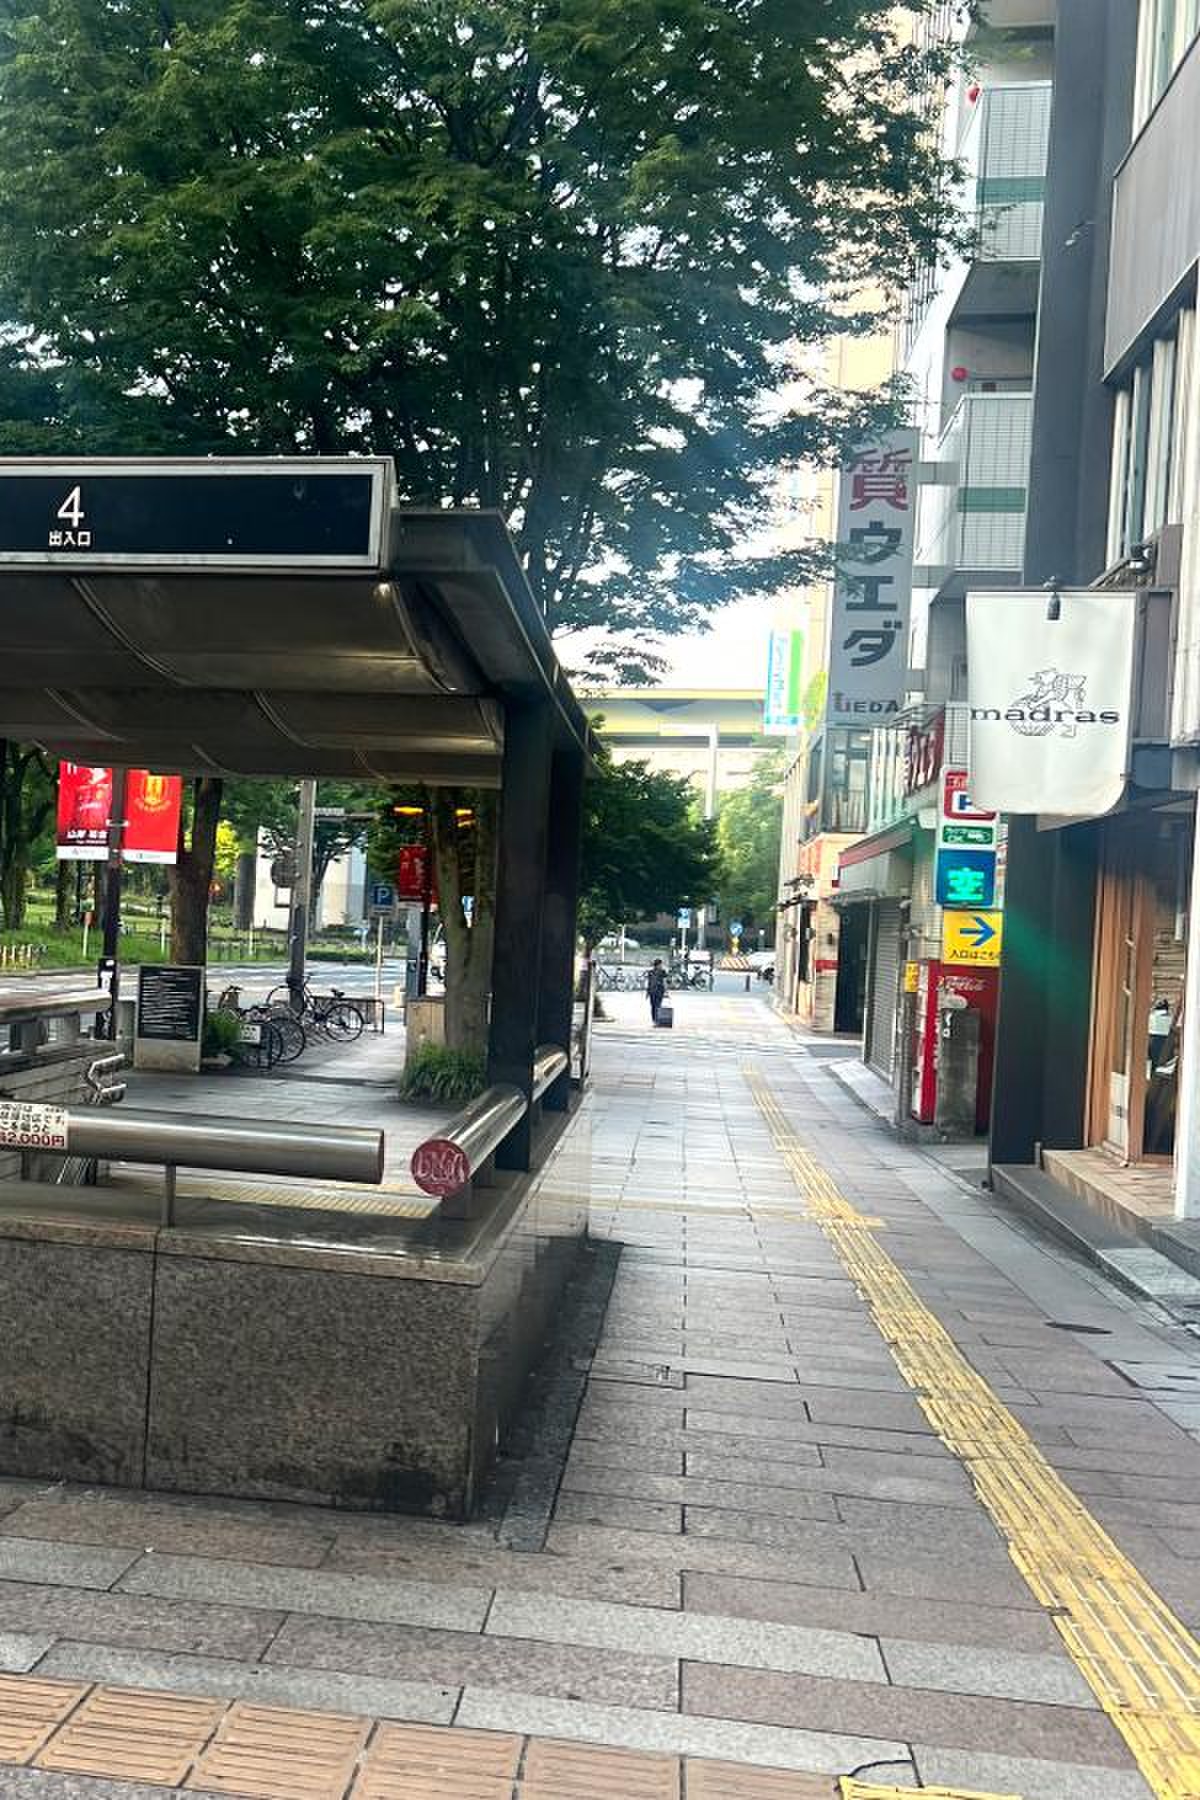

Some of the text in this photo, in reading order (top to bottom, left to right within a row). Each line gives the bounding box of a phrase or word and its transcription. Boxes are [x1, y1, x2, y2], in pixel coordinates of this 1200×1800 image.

[57, 486, 85, 527] 4
[49, 531, 91, 546] 出入口
[843, 447, 912, 667] 質ウエダ
[970, 705, 1120, 725] madras
